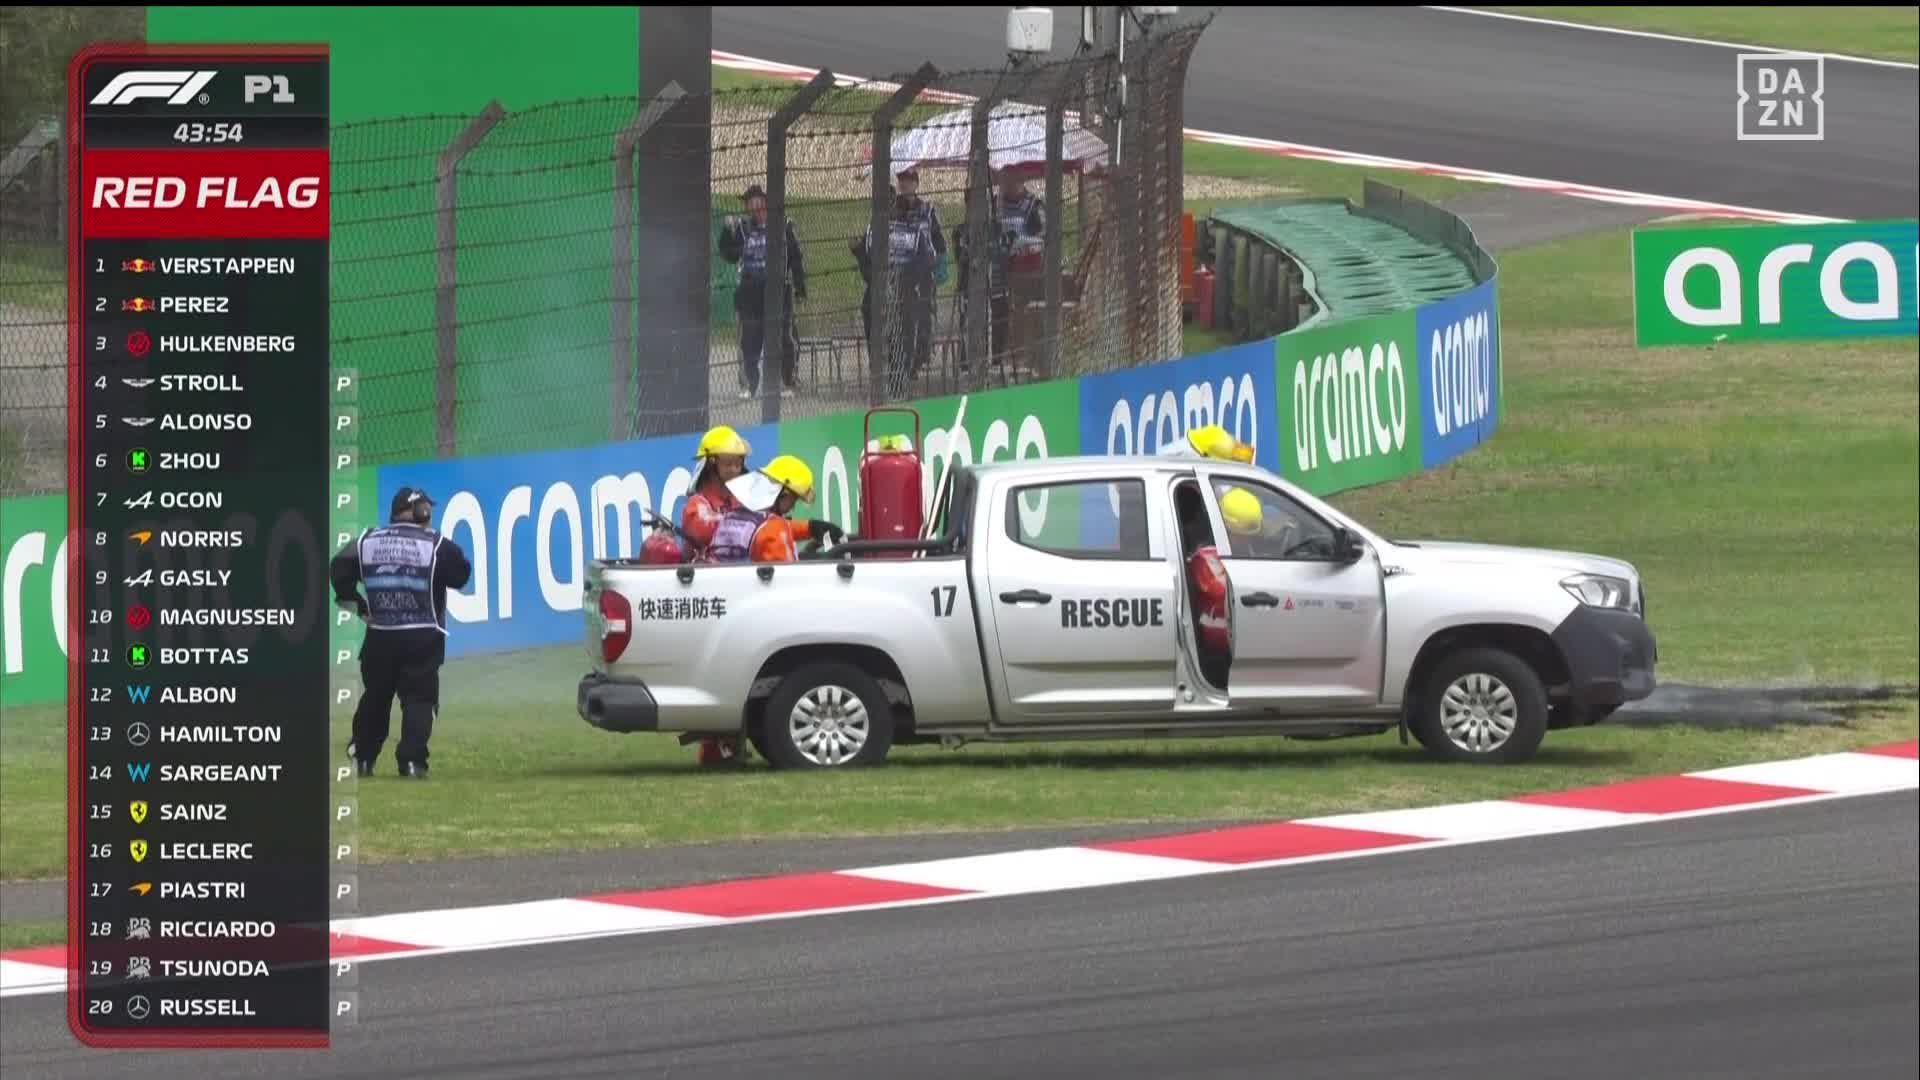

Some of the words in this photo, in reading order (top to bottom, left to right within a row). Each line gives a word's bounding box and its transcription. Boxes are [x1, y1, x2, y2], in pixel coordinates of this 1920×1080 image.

[1663, 241, 1917, 326] ara
[1293, 341, 1406, 472] aramco
[1431, 309, 1489, 436] aramco
[440, 466, 692, 623] aram
[638, 597, 727, 621] 快速消防车
[930, 585, 957, 618] 17
[1061, 598, 1164, 628] RESCUE
